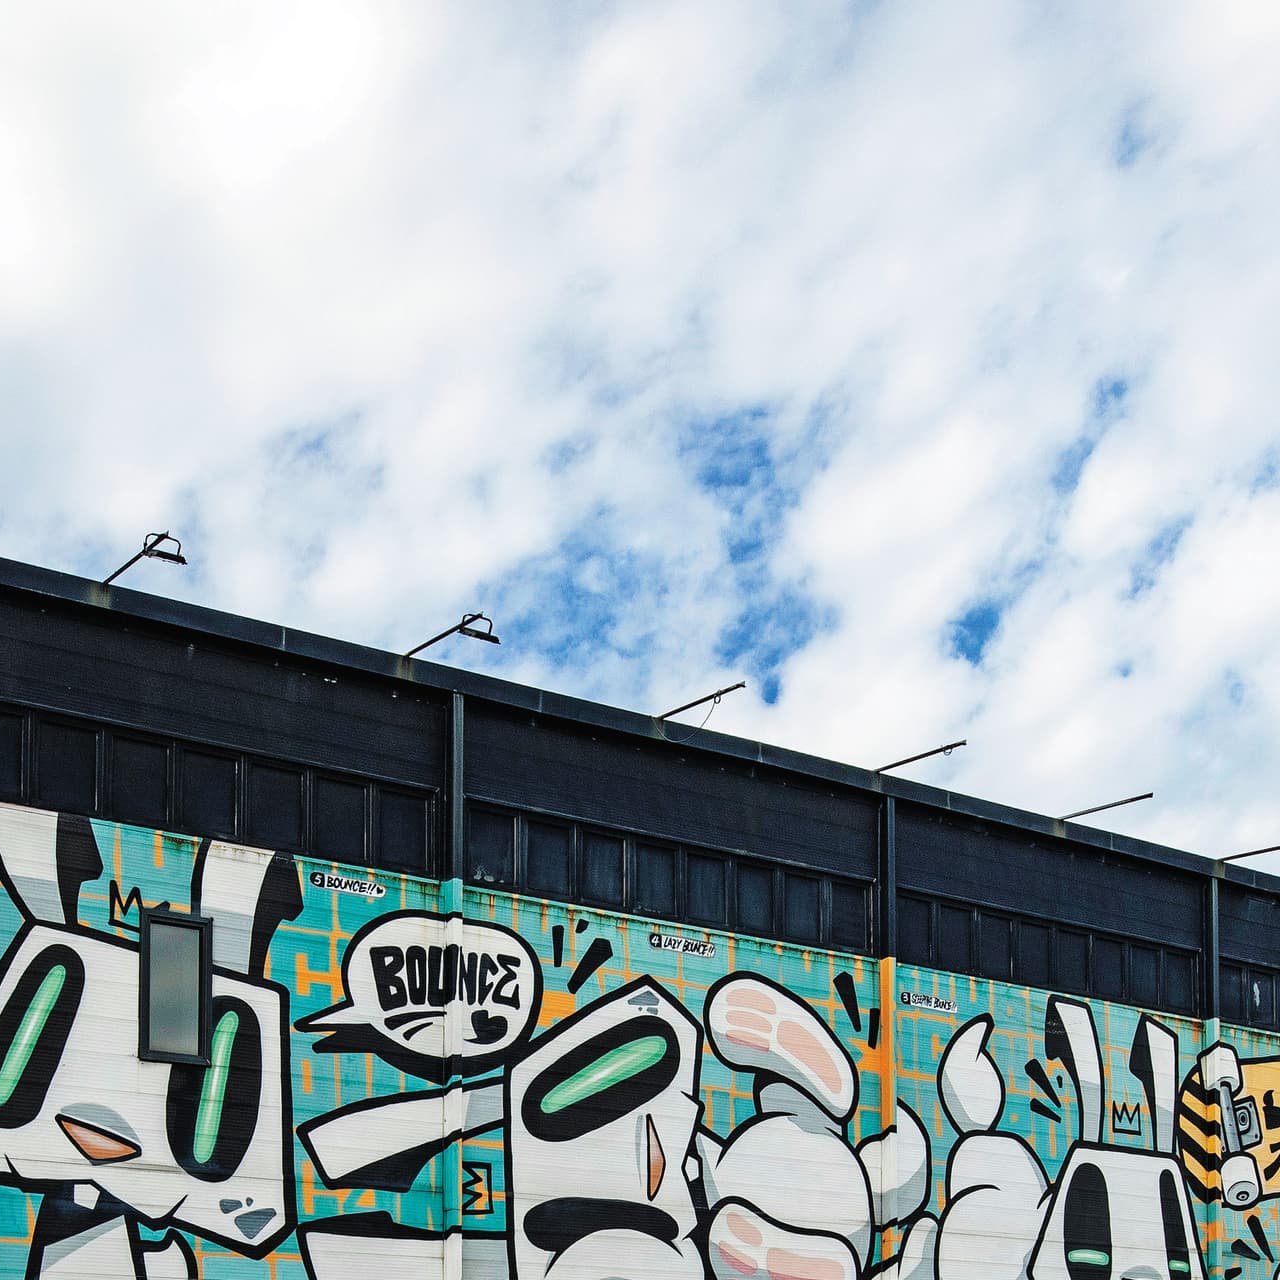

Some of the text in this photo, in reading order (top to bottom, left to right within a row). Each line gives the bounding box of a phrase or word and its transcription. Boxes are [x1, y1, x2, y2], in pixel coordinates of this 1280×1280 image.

[314, 874, 377, 895] 5 BOUNCE!!
[651, 935, 659, 946] 4
[664, 937, 682, 949] LAZY
[369, 944, 520, 1011] BOUNCE
